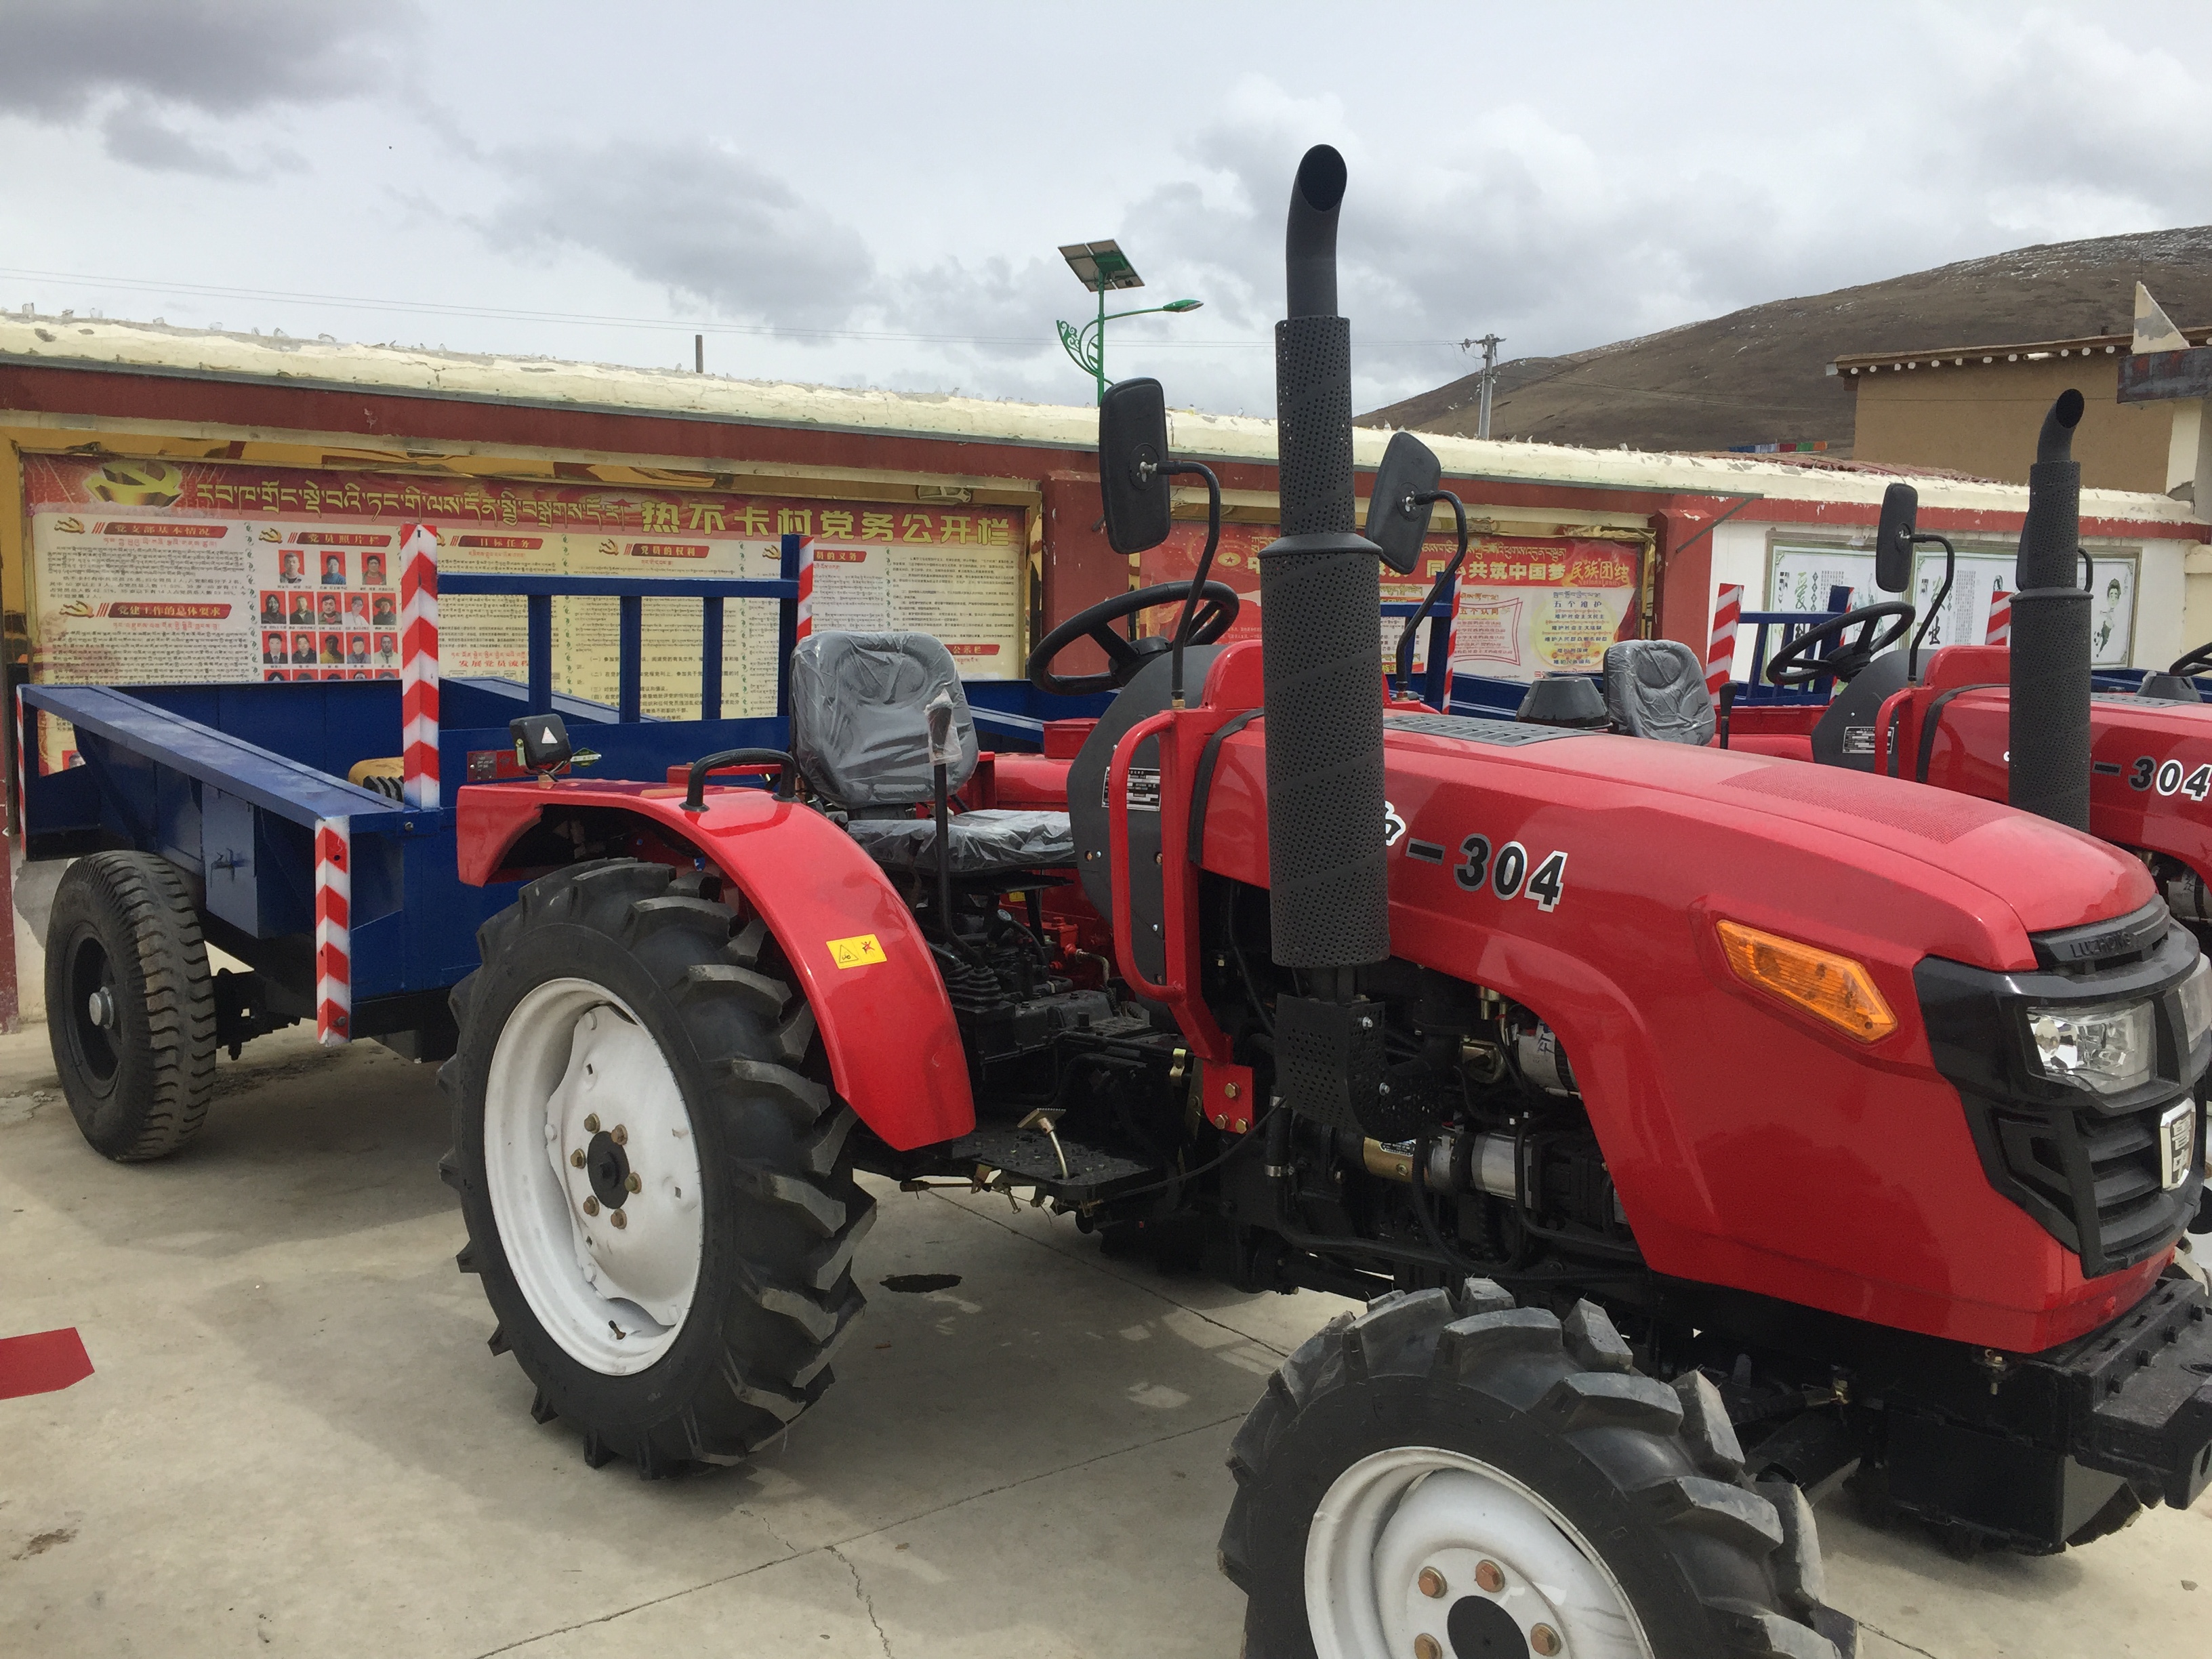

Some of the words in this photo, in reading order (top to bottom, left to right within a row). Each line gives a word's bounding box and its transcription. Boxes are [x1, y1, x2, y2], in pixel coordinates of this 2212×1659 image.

[640, 500, 1009, 546] 热不卡村党务公开栏
[480, 537, 530, 548] 目标任务
[640, 545, 696, 556] 党员的权利
[1572, 560, 1630, 583] 民族团结
[118, 605, 222, 617] 党建工作的总体要求
